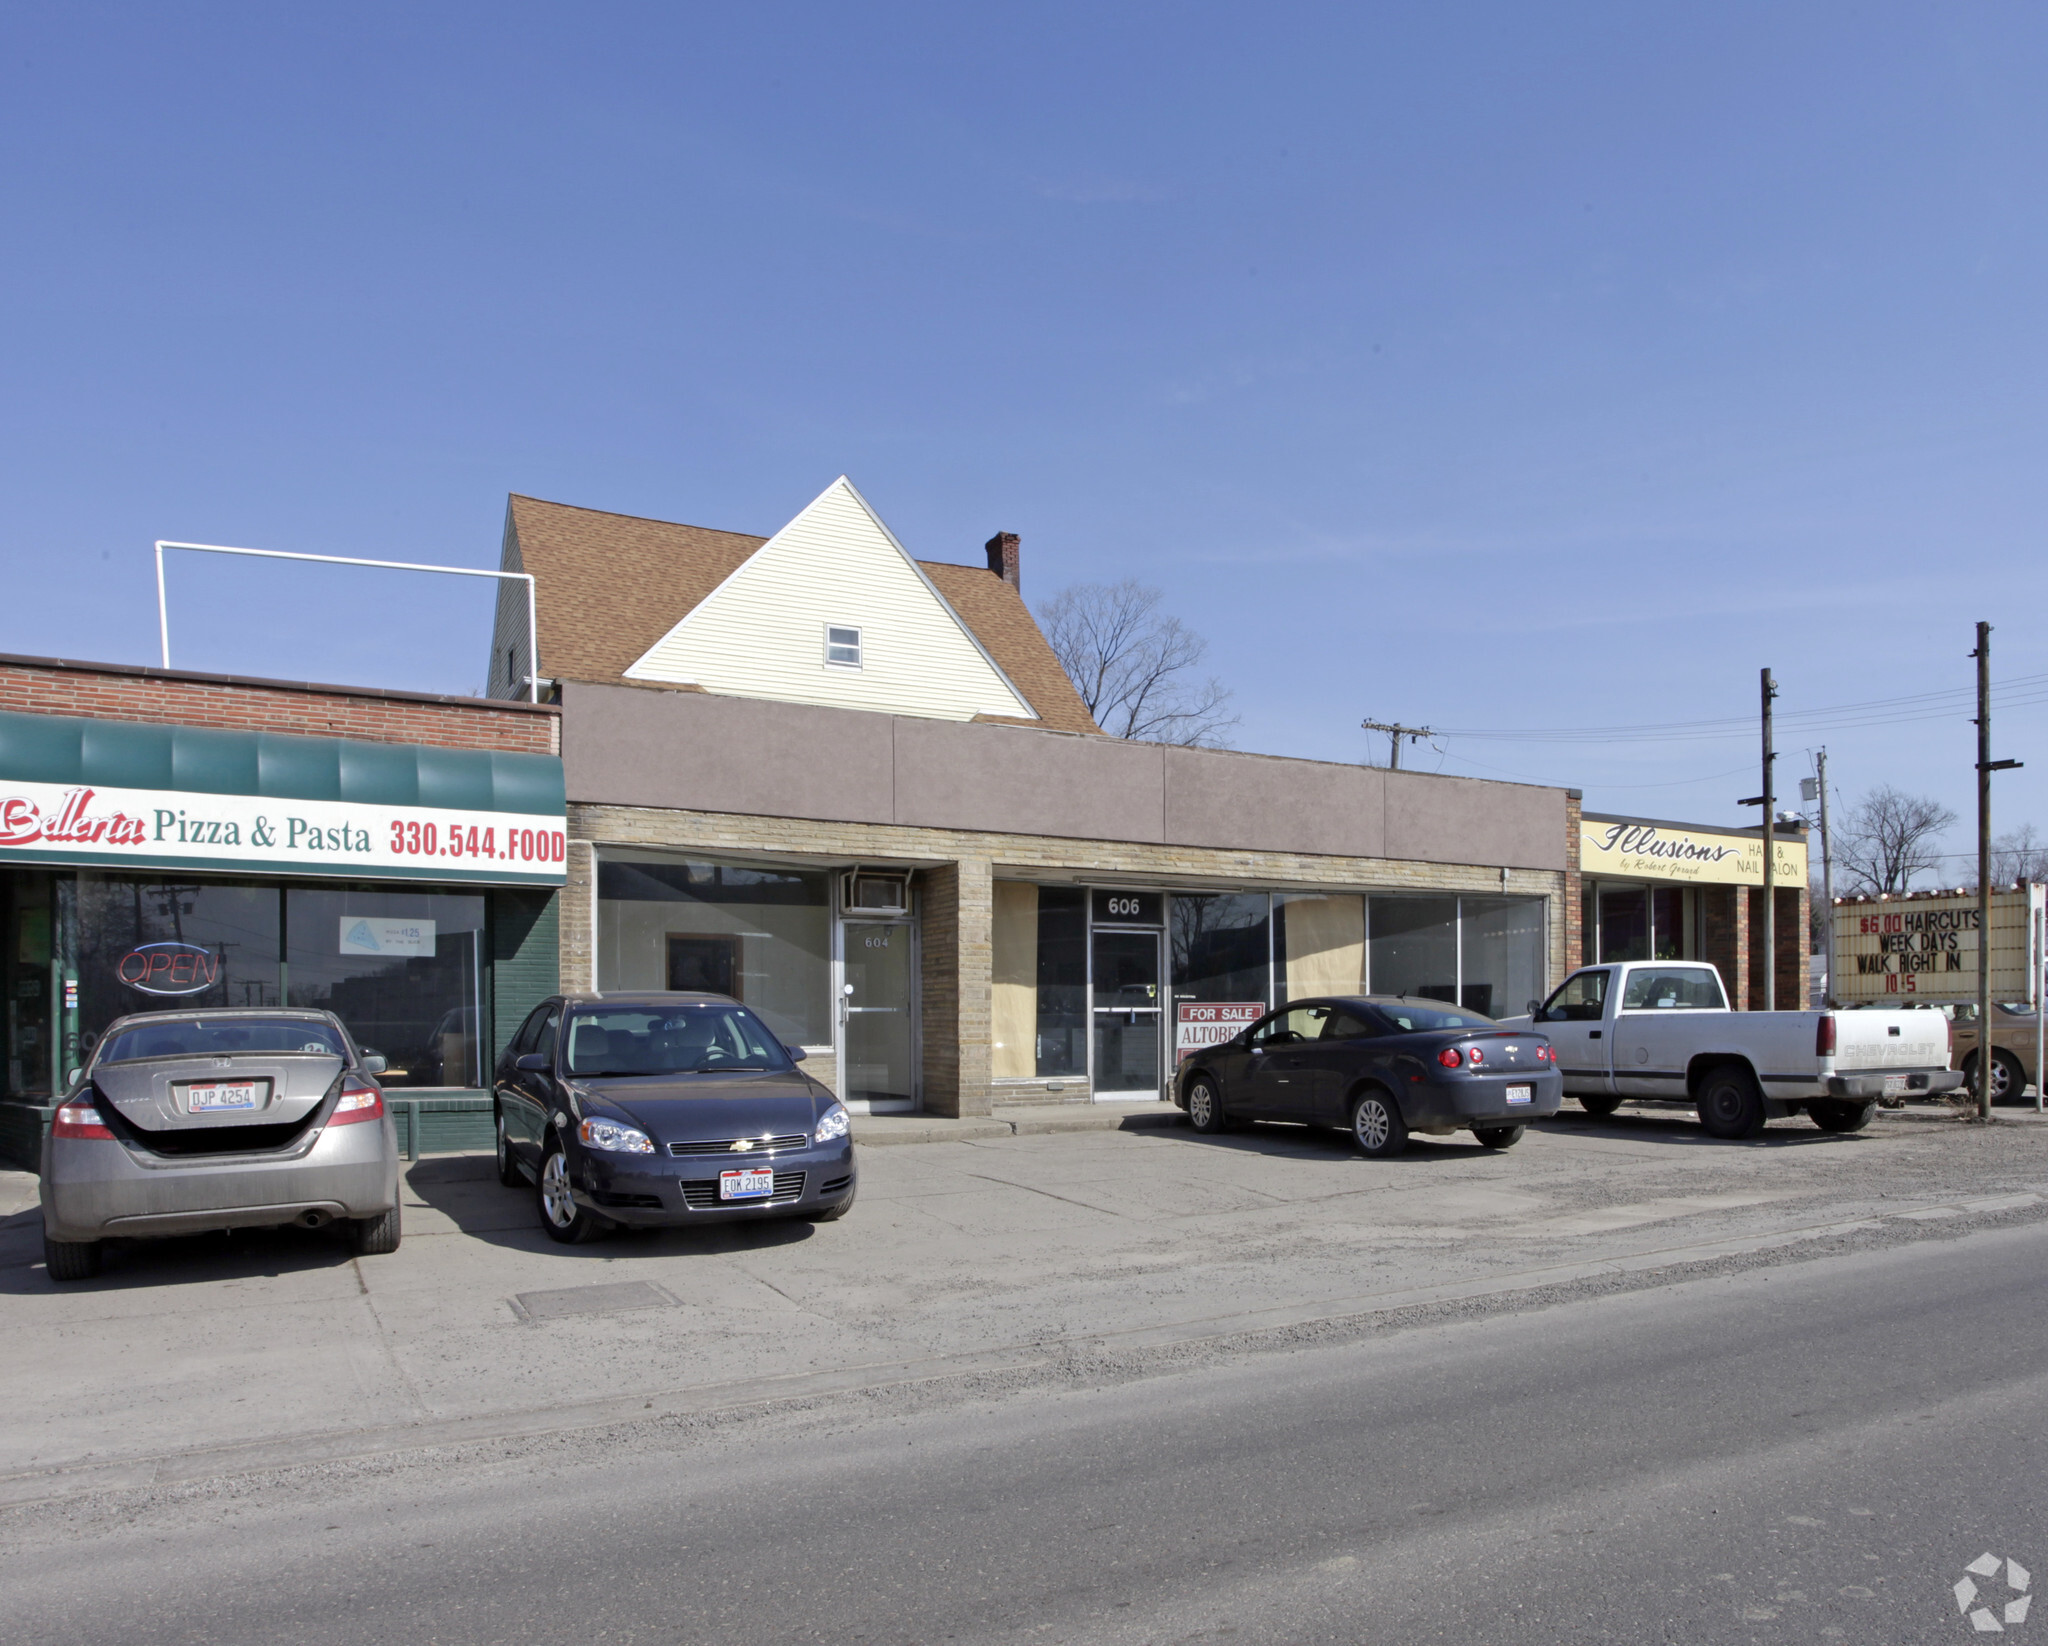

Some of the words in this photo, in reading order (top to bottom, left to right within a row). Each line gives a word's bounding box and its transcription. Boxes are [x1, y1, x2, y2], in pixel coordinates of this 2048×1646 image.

[0, 787, 146, 846] Belleria
[153, 809, 242, 846] Pizza
[251, 815, 276, 847] &
[286, 817, 372, 852] Pasta
[390, 820, 565, 862] 330.544.FOOD
[1585, 824, 1741, 861] Illusions
[1748, 843, 1763, 857] HA
[1777, 846, 1785, 859] &
[1619, 858, 1630, 872] by
[1634, 859, 1667, 872] Robert
[1737, 860, 1760, 874] NAIL
[1771, 862, 1798, 876] ALON
[1108, 898, 1140, 915] 606
[1905, 910, 1980, 931] HAIRCUTS
[865, 937, 889, 948] 604
[1880, 934, 1915, 953] WEEK
[1921, 932, 1957, 951] DAYS
[119, 952, 220, 983] OPEN
[1857, 954, 1891, 974] WALK
[1900, 953, 1938, 973] RIGHT
[1946, 952, 1961, 971] IN
[1189, 1008, 1216, 1020] FOR
[1221, 1008, 1254, 1020] SALE
[1844, 1043, 1935, 1058] CHEVROLET
[193, 1091, 216, 1106] DJP
[220, 1089, 250, 1104] 4254
[745, 1176, 770, 1191] 2195
